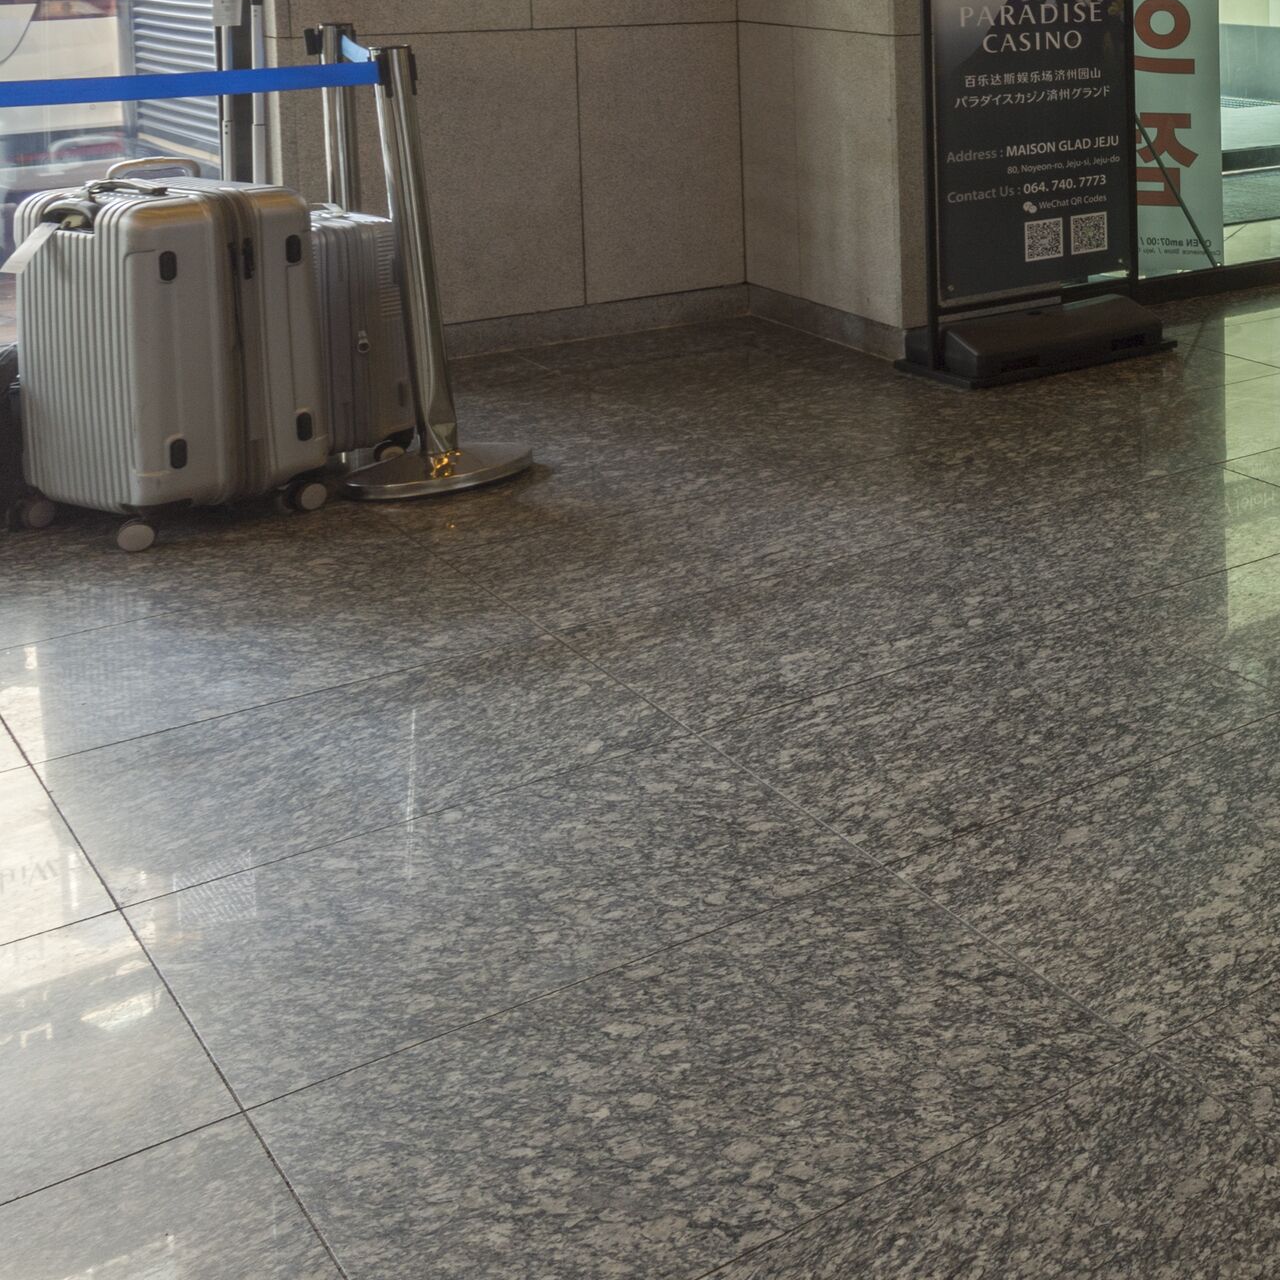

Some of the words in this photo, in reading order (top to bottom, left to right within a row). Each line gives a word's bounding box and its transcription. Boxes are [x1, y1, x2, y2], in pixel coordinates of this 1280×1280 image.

[960, 1, 1102, 27] PARADISE
[982, 30, 1082, 53] CASINO
[946, 151, 997, 163] Address
[1006, 141, 1055, 157] MAISON
[1059, 138, 1091, 151] GLAD
[1093, 135, 1119, 148] JEJU
[948, 188, 996, 203] Contact
[1000, 186, 1015, 196] Us
[1080, 175, 1106, 187] 7773
[1039, 199, 1069, 209] WeChat
[1071, 197, 1082, 205] QR
[1084, 194, 1107, 203] Codes
